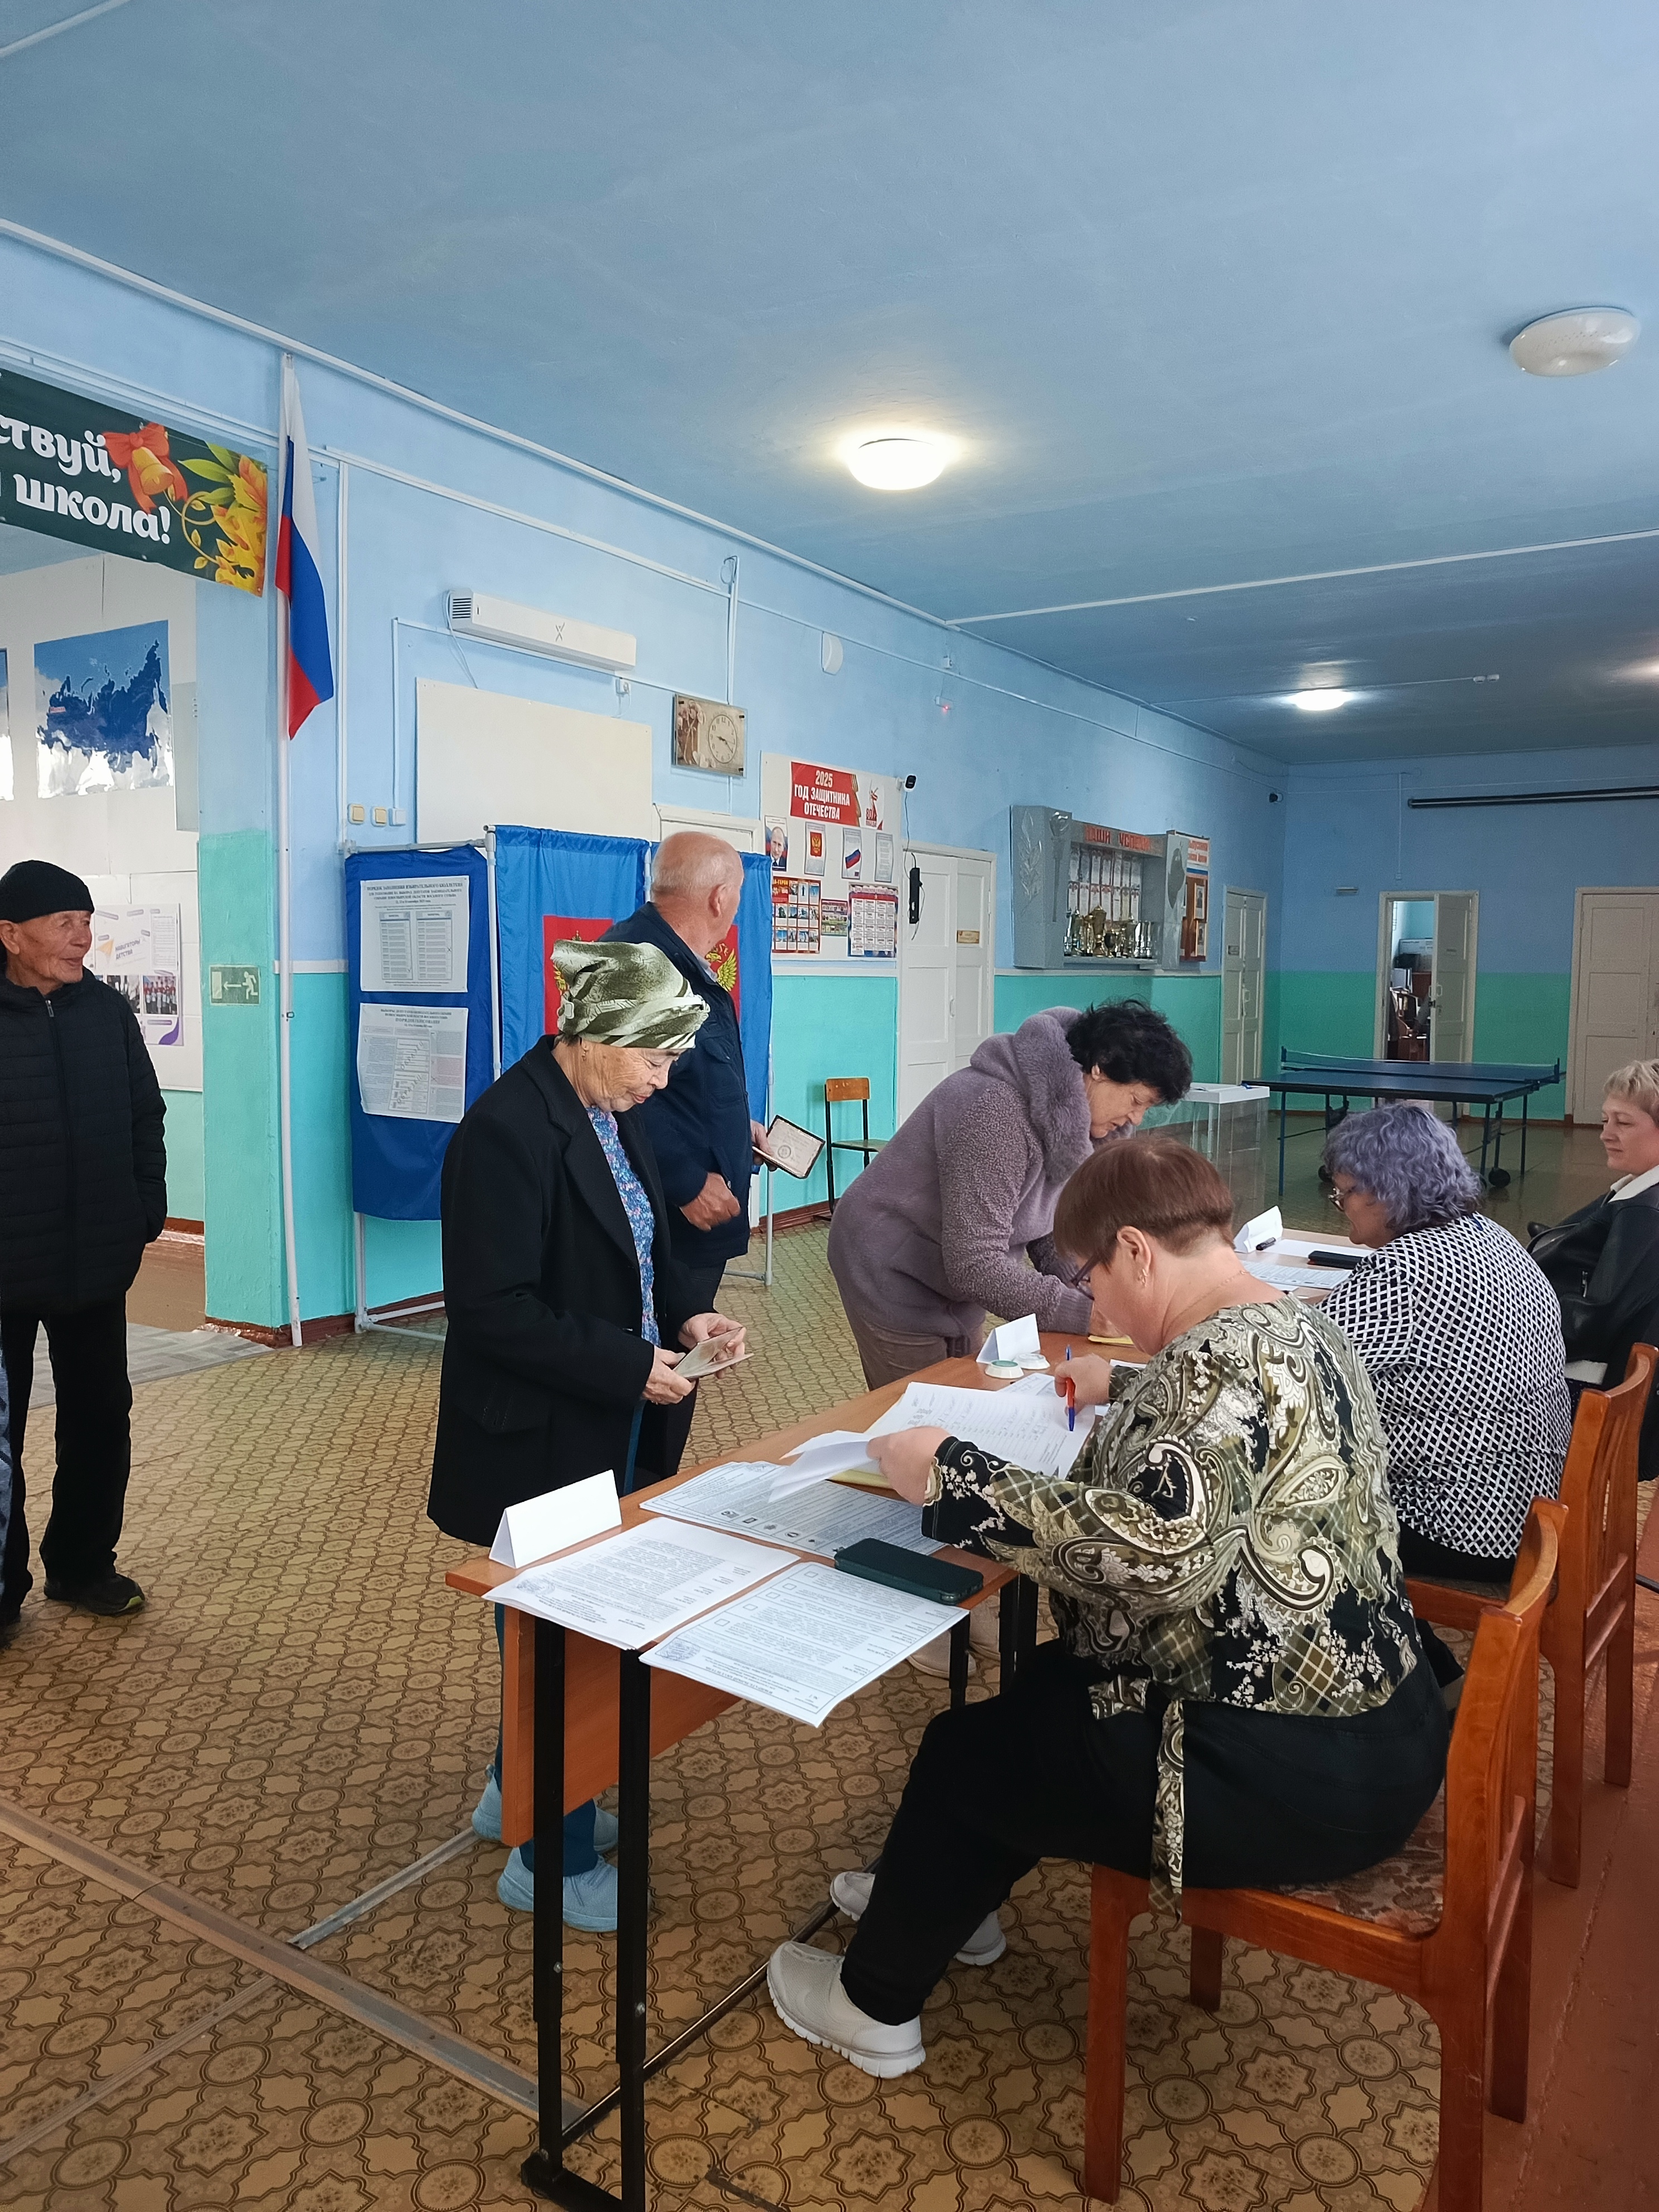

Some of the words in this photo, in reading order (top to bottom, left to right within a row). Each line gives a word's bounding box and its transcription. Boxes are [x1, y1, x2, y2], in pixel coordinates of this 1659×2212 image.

[13, 474, 171, 544] школа!
[815, 770, 833, 788] 2025
[794, 784, 809, 801] ГОД
[811, 787, 850, 806] ЗАЩИТНИКА
[804, 802, 840, 819] ОТЕЧЕСТВА
[1085, 824, 1111, 844] НАШИ
[1119, 832, 1152, 852] УСПЕХИ
[115, 949, 133, 960] ДЕТСТВА
